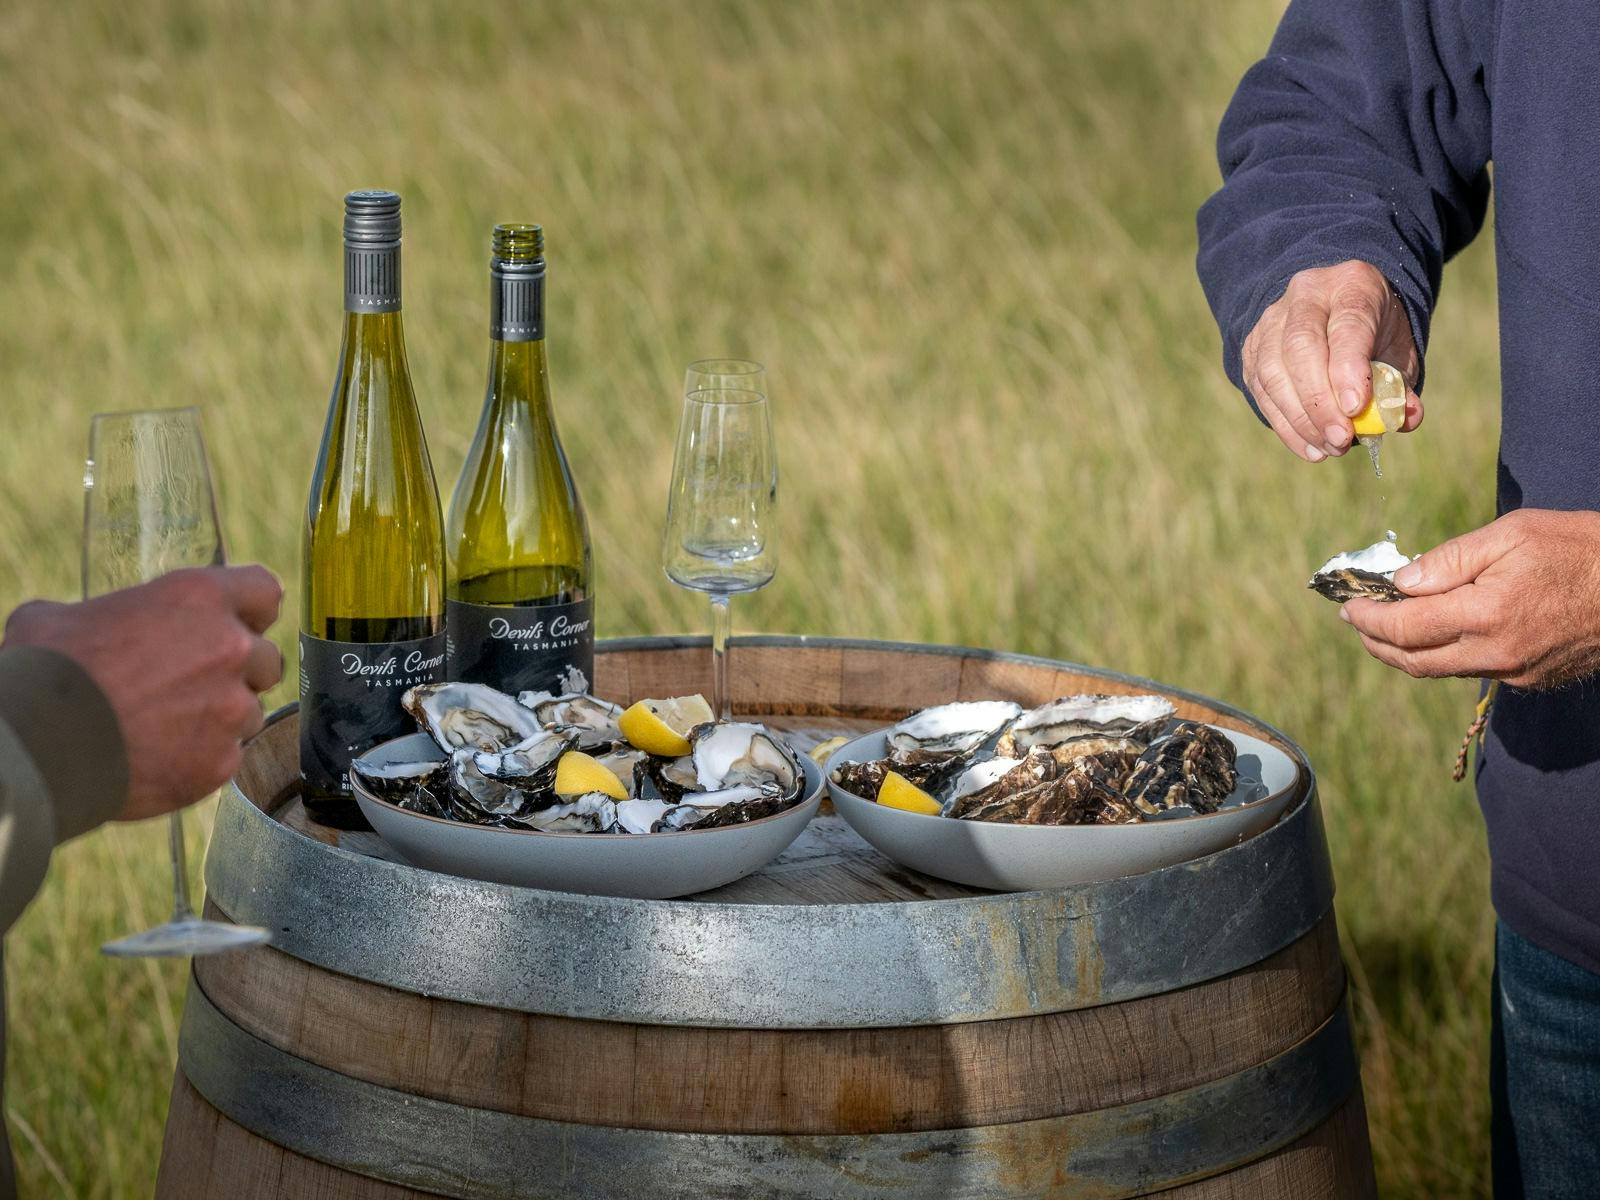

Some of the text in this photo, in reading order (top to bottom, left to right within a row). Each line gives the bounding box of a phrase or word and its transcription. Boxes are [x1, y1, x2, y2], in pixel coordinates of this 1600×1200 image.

[549, 614, 591, 637] Corner
[513, 637, 579, 651] TASMANIA
[403, 649, 445, 673] Corner
[365, 672, 434, 688] TASMANIA
